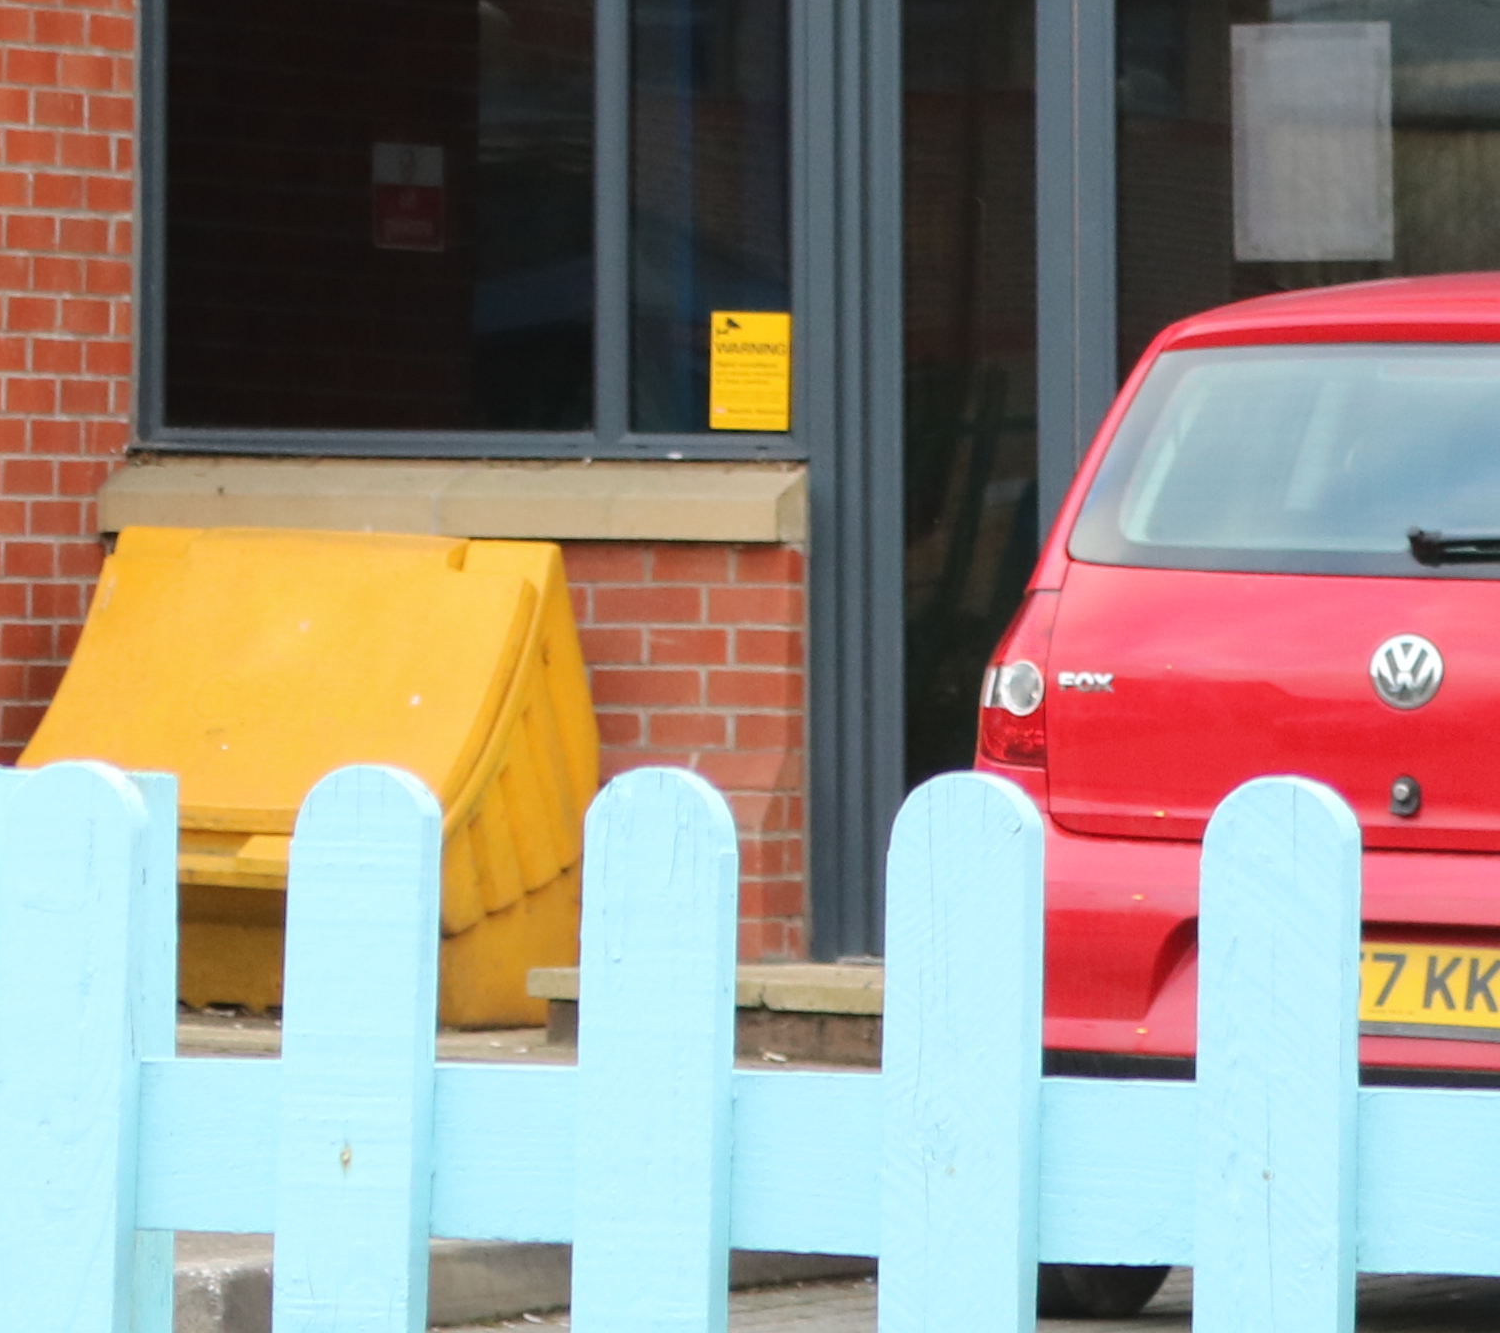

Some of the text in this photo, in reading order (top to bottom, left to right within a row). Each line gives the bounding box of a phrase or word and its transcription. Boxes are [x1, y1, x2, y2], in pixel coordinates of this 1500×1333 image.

[715, 342, 788, 356] WARNING
[1057, 670, 1115, 693] FOX
[1359, 951, 1408, 1007] 7
